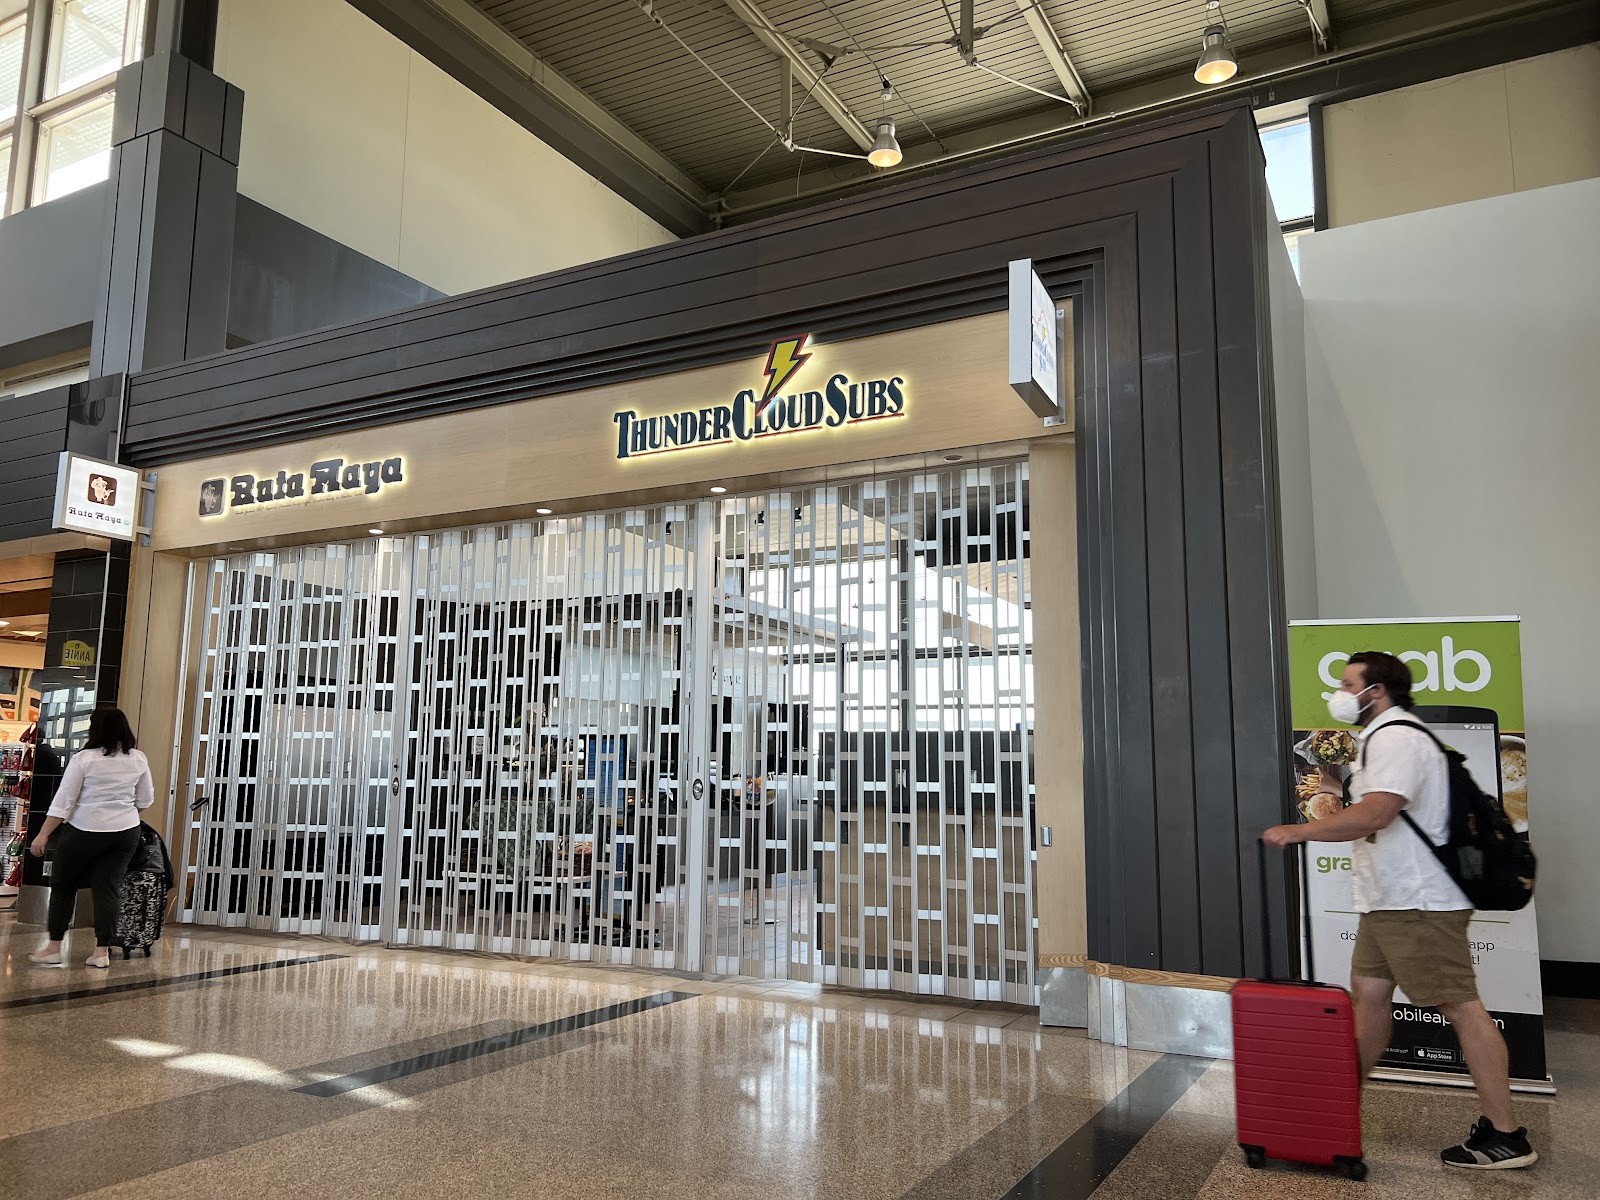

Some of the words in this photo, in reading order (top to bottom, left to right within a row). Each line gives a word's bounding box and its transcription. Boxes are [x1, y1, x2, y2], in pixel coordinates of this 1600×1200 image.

[231, 471, 304, 506] Ruta
[310, 457, 403, 495] Maya
[68, 506, 93, 518] Ruta
[95, 512, 122, 524] Maya
[1317, 635, 1492, 701] gab
[1316, 855, 1352, 873] gra
